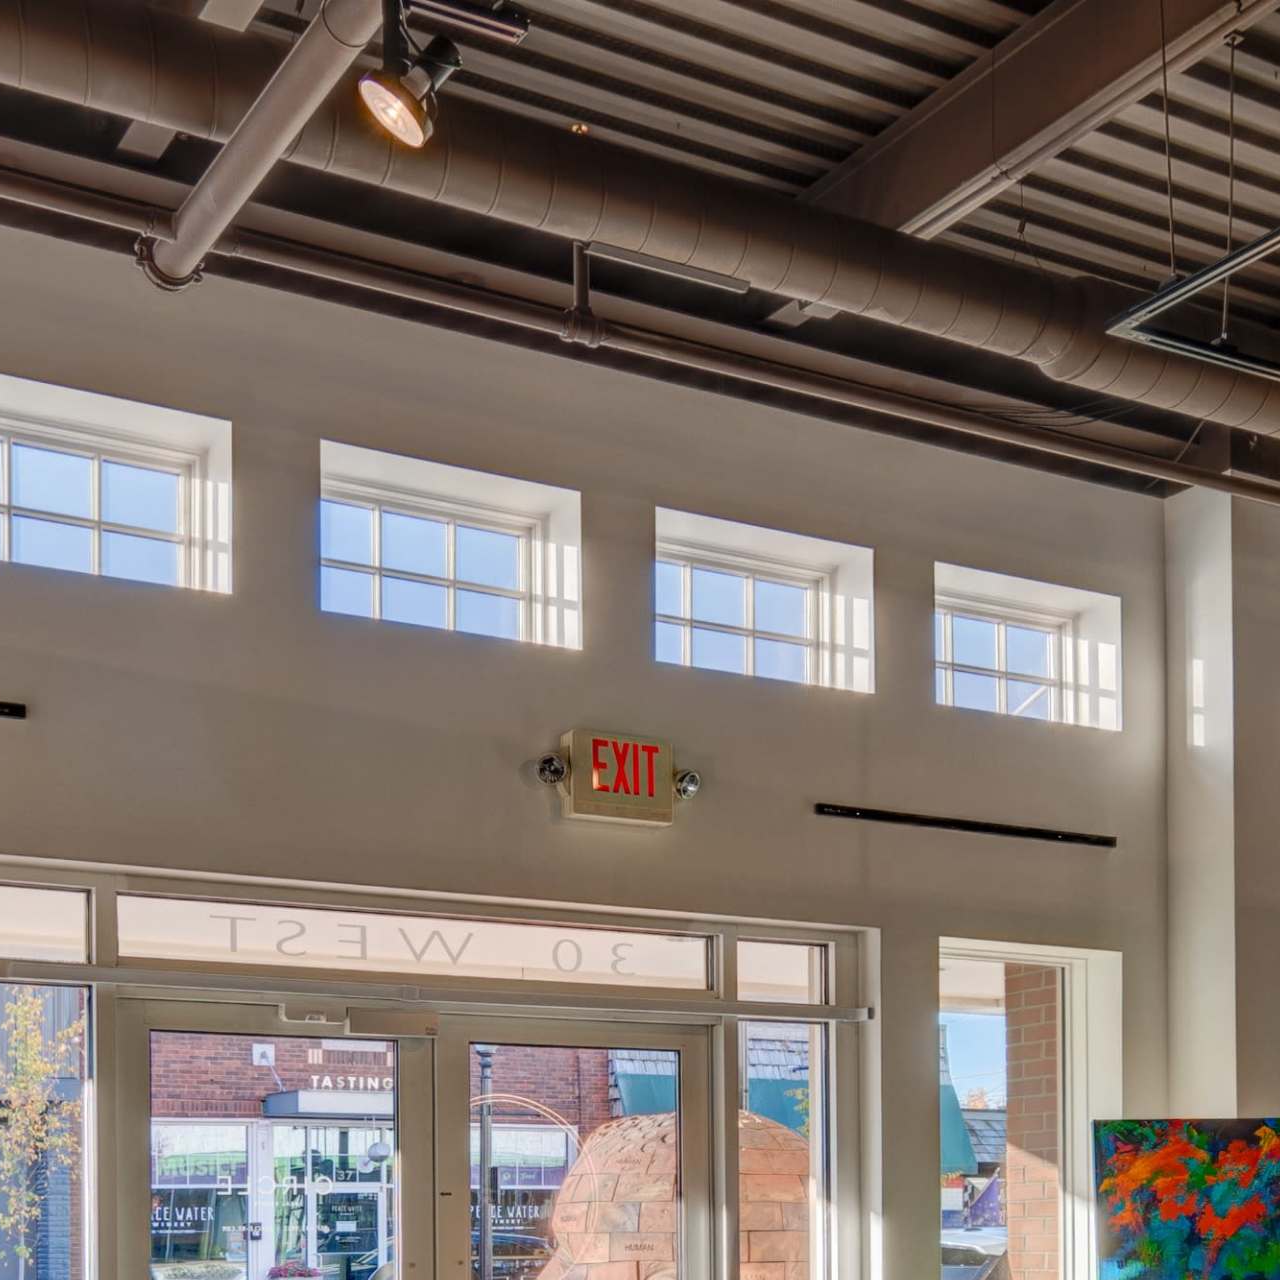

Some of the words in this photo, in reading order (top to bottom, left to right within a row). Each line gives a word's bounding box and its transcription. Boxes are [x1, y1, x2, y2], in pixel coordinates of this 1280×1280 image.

[591, 737, 659, 797] EXIT
[310, 1074, 394, 1089] TASTING
[336, 1170, 354, 1181] 37
[175, 1206, 215, 1221] WATER
[469, 1205, 502, 1218] PECE
[506, 1205, 540, 1218] WATER
